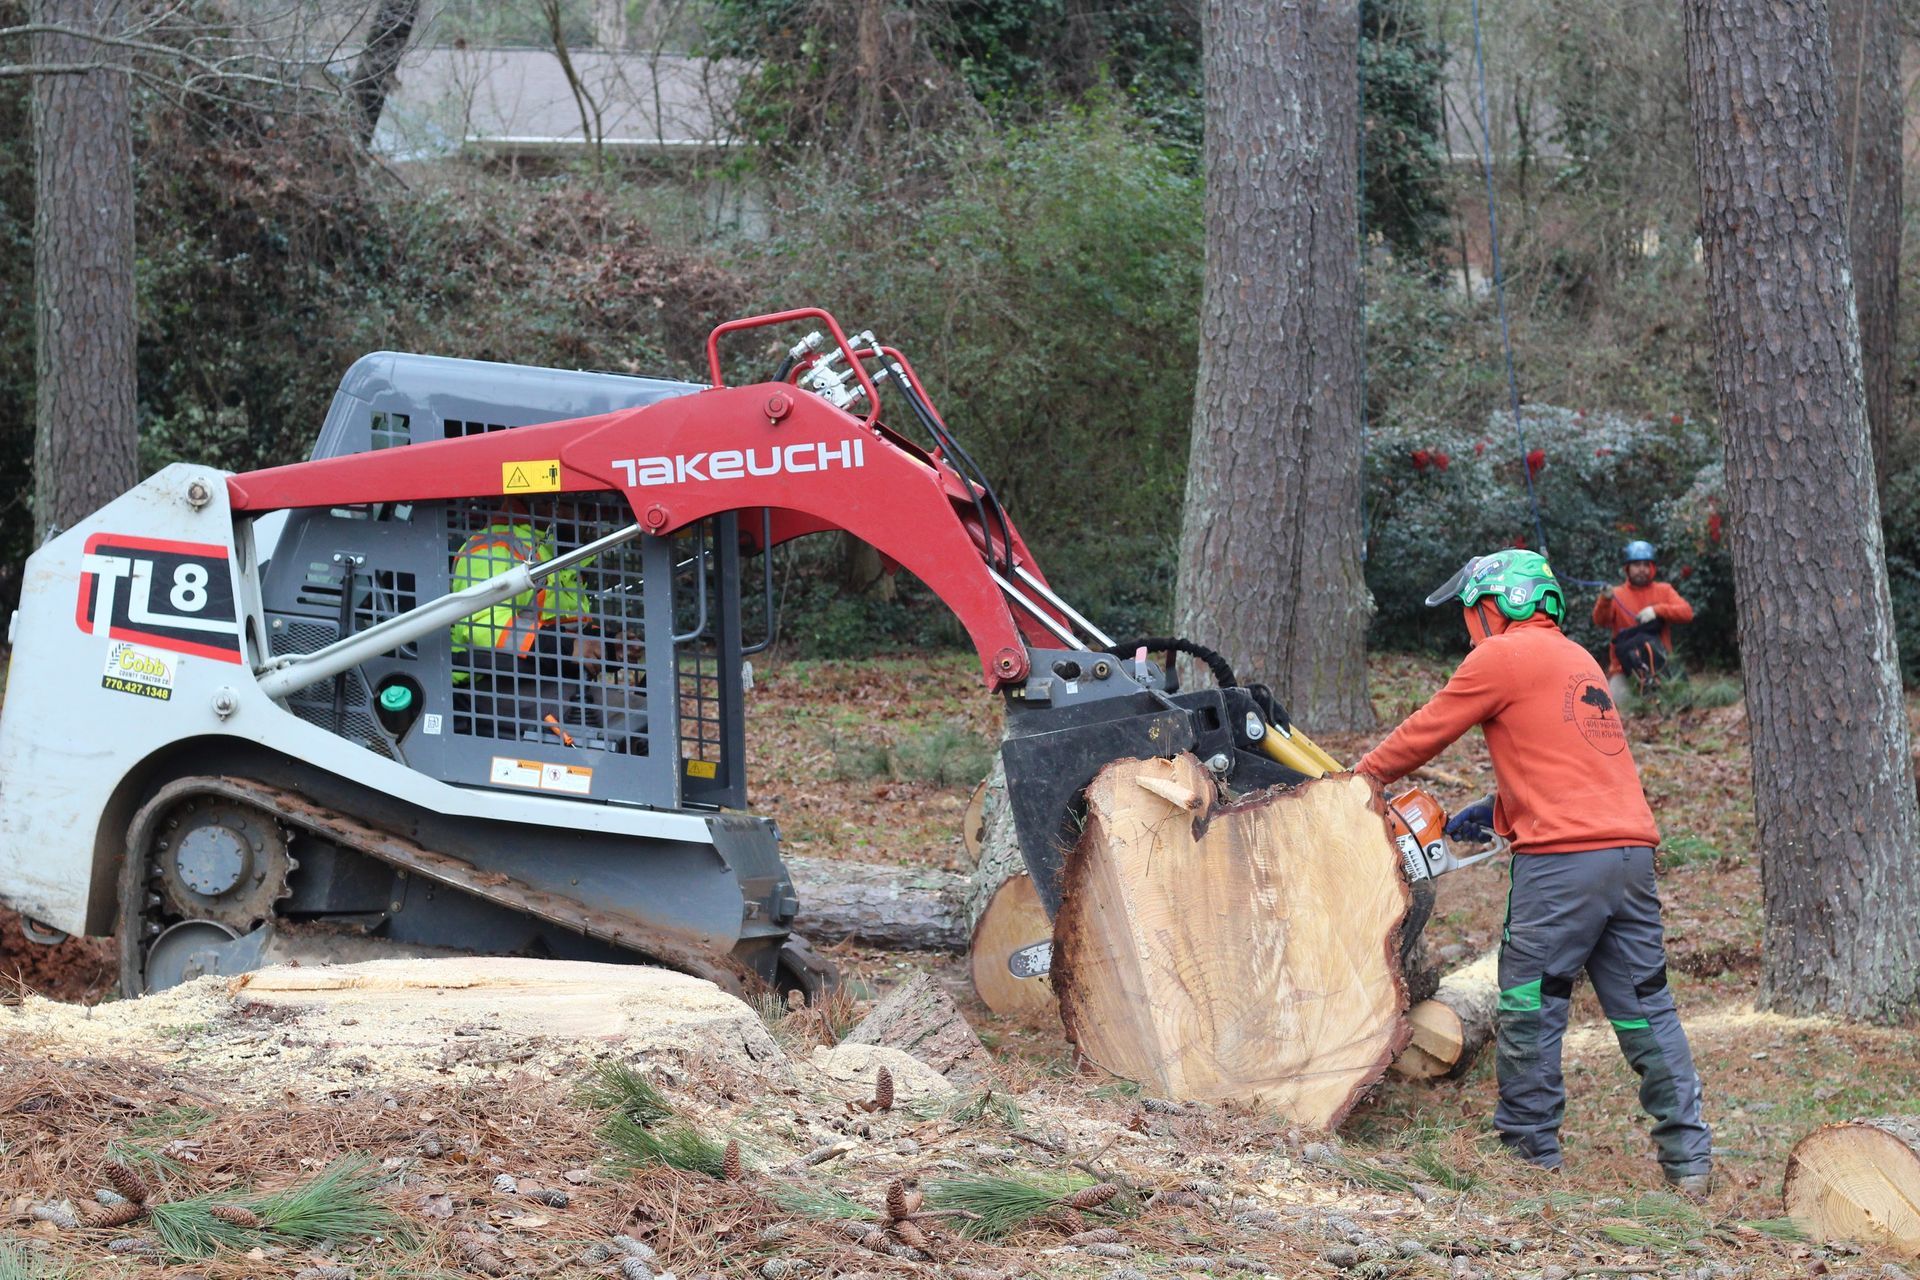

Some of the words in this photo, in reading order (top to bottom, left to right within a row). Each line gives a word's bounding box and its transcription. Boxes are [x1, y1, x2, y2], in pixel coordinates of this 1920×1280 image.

[118, 648, 166, 677] Cobb
[118, 669, 138, 680] COUNTY
[139, 673, 161, 683] TRACTOR
[105, 677, 169, 700] 770.427.1348
